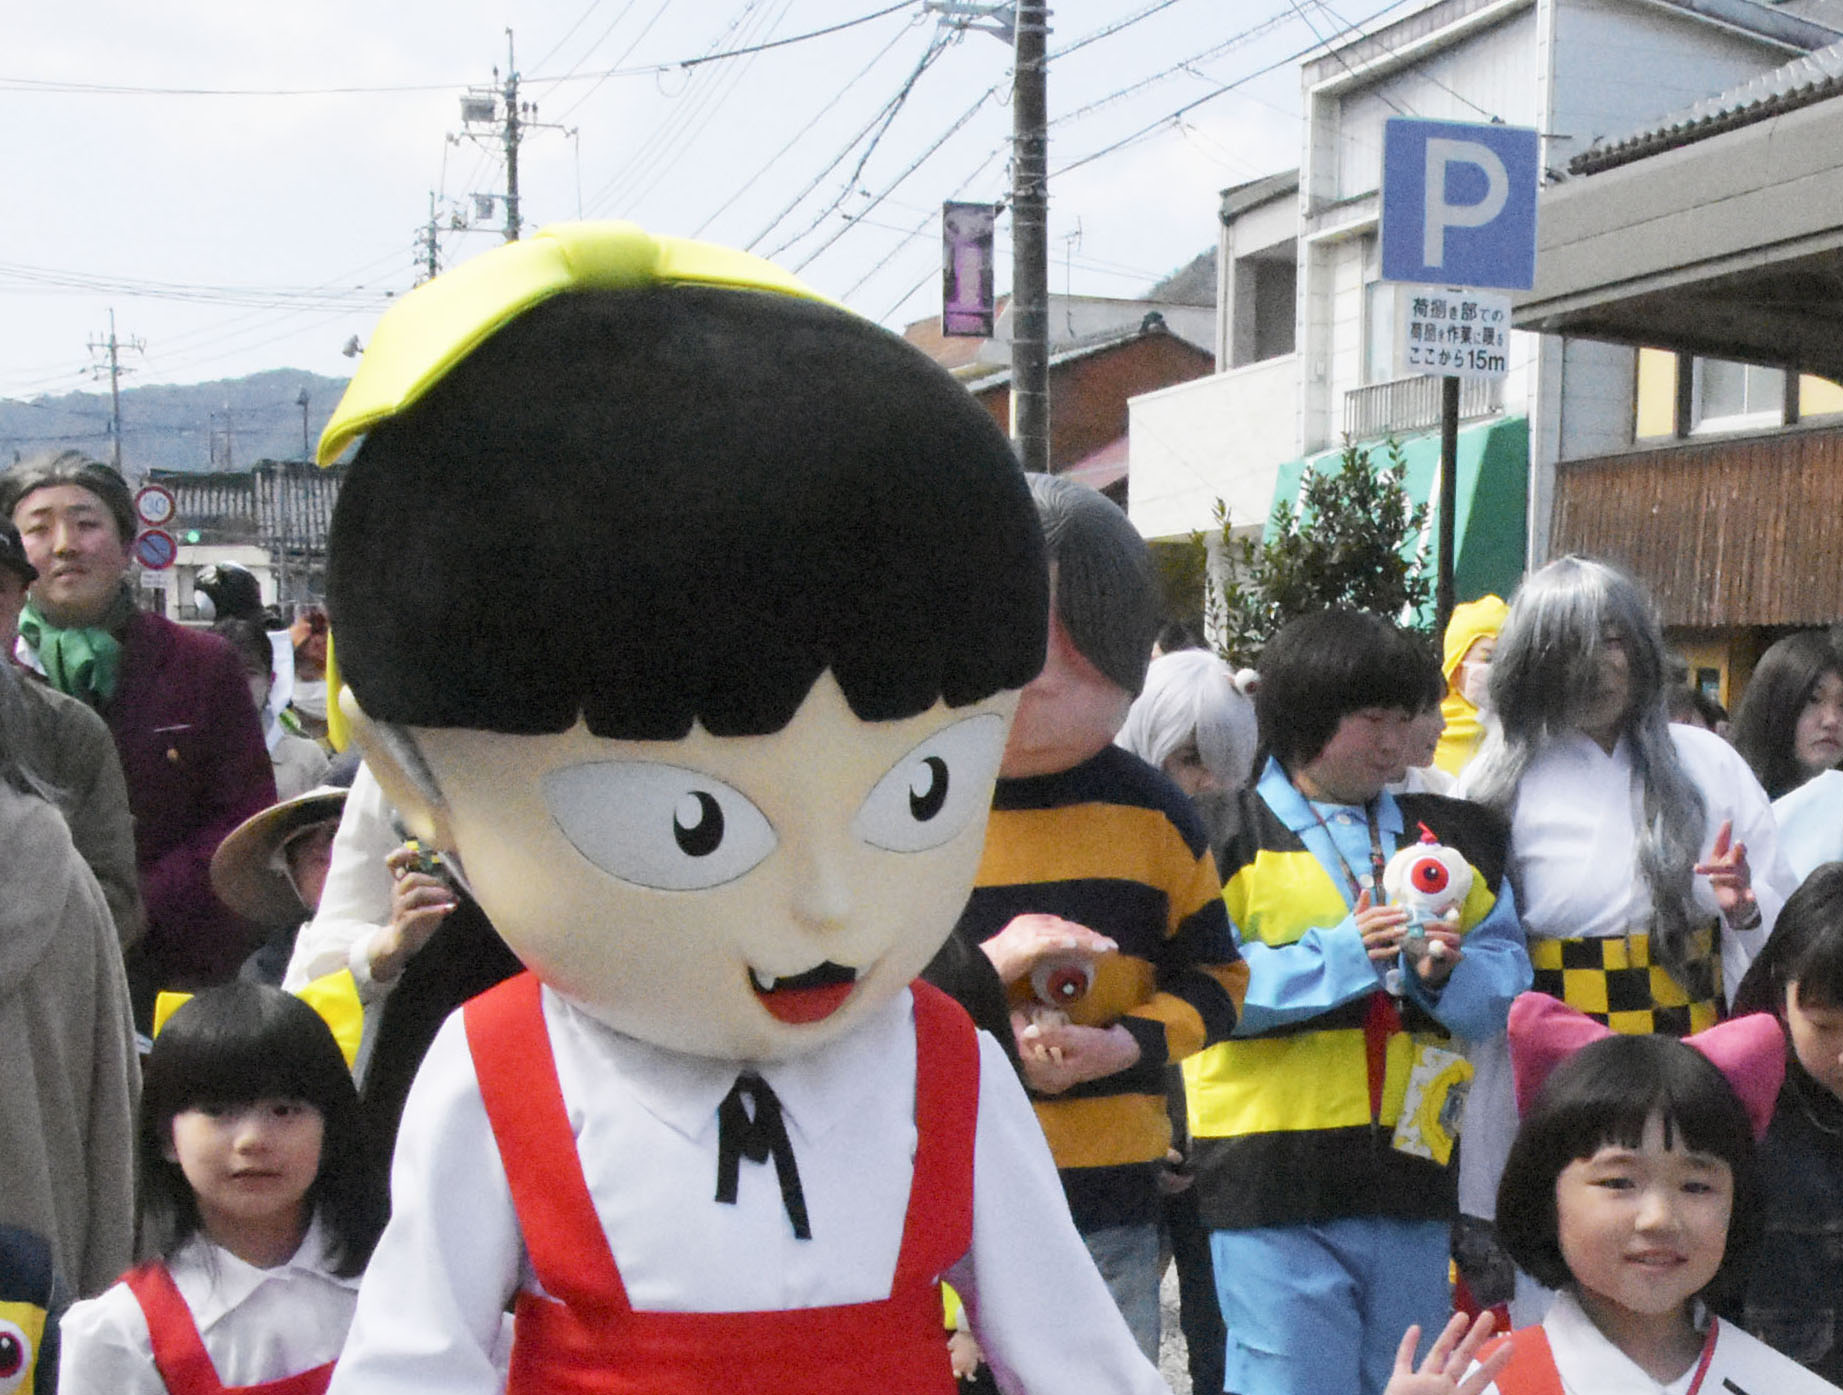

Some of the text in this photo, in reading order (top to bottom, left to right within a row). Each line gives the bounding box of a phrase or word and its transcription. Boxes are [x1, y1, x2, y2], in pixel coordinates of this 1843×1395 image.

[1423, 137, 1509, 268] P
[1409, 346, 1505, 371] ここから15m
